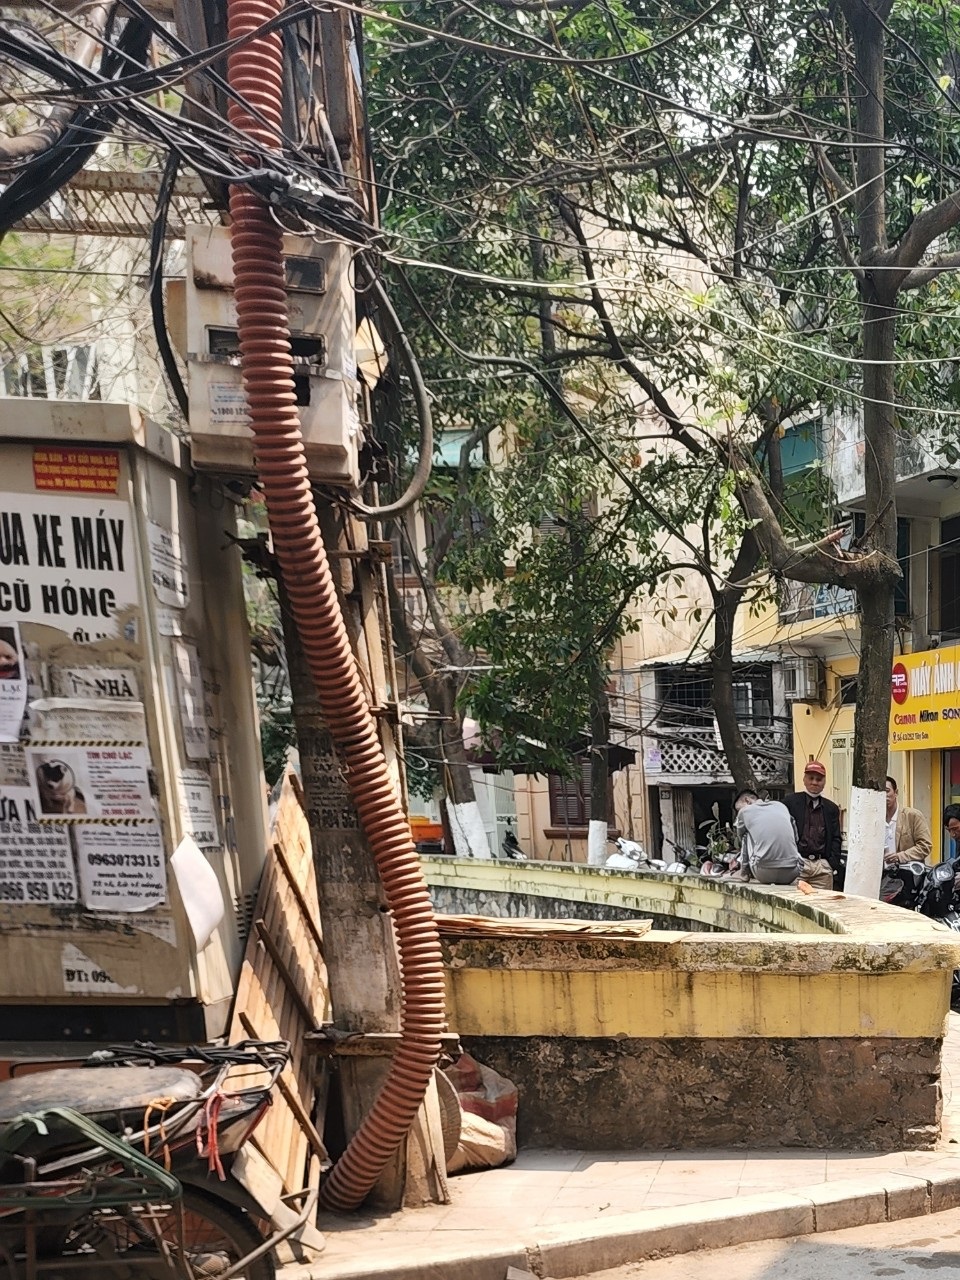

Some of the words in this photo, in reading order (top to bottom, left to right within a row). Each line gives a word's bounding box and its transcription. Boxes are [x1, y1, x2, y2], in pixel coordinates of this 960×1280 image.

[32, 513, 66, 569] XE
[71, 508, 125, 572] MÁY
[0, 578, 31, 613] CŨ
[41, 578, 117, 618] HỎNG
[911, 660, 931, 697] MÁY
[934, 653, 956, 694] ẢNH
[894, 713, 917, 726] Canon
[919, 709, 939, 723] Nikon
[87, 853, 161, 868] 0963073315
